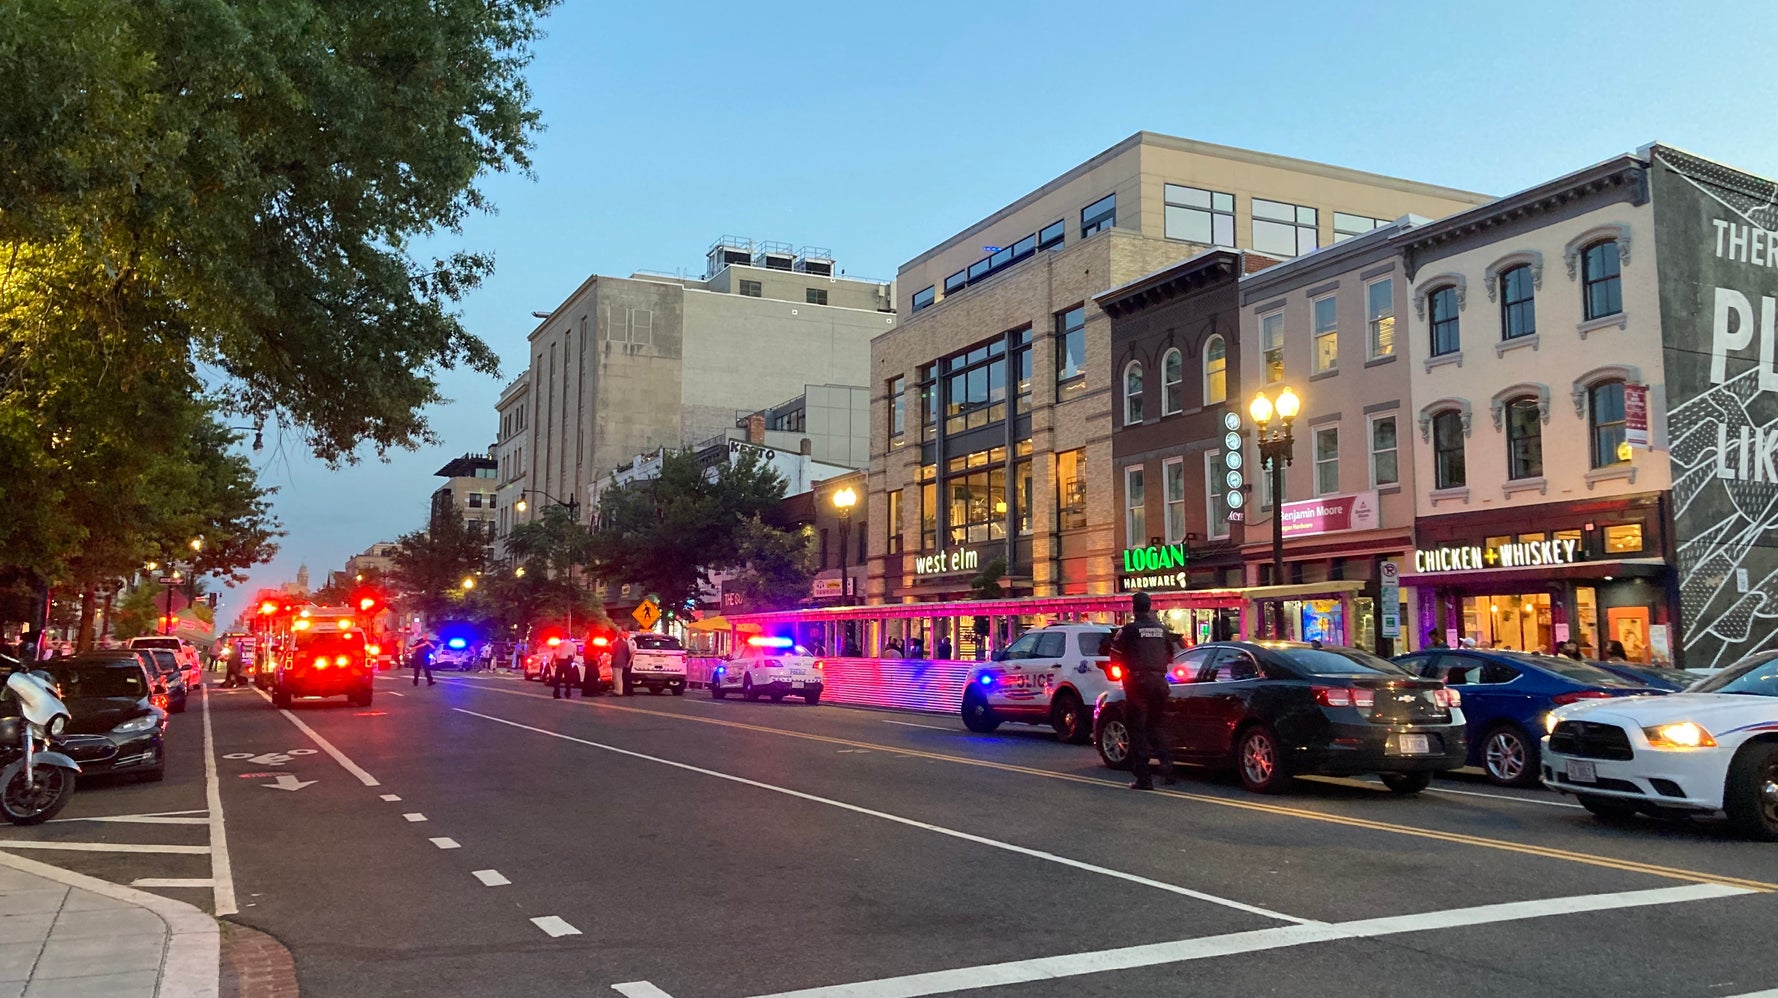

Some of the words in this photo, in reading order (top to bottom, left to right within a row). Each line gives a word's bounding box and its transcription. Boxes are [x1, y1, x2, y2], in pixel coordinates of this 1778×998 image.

[1317, 505, 1343, 517] Moore
[916, 550, 947, 575] west
[951, 547, 978, 571] elm
[1123, 543, 1185, 572] LOGAN
[1415, 546, 1483, 573] CHICKEN
[1500, 539, 1575, 567] WHISKEY
[1123, 575, 1176, 589] HARDWARE
